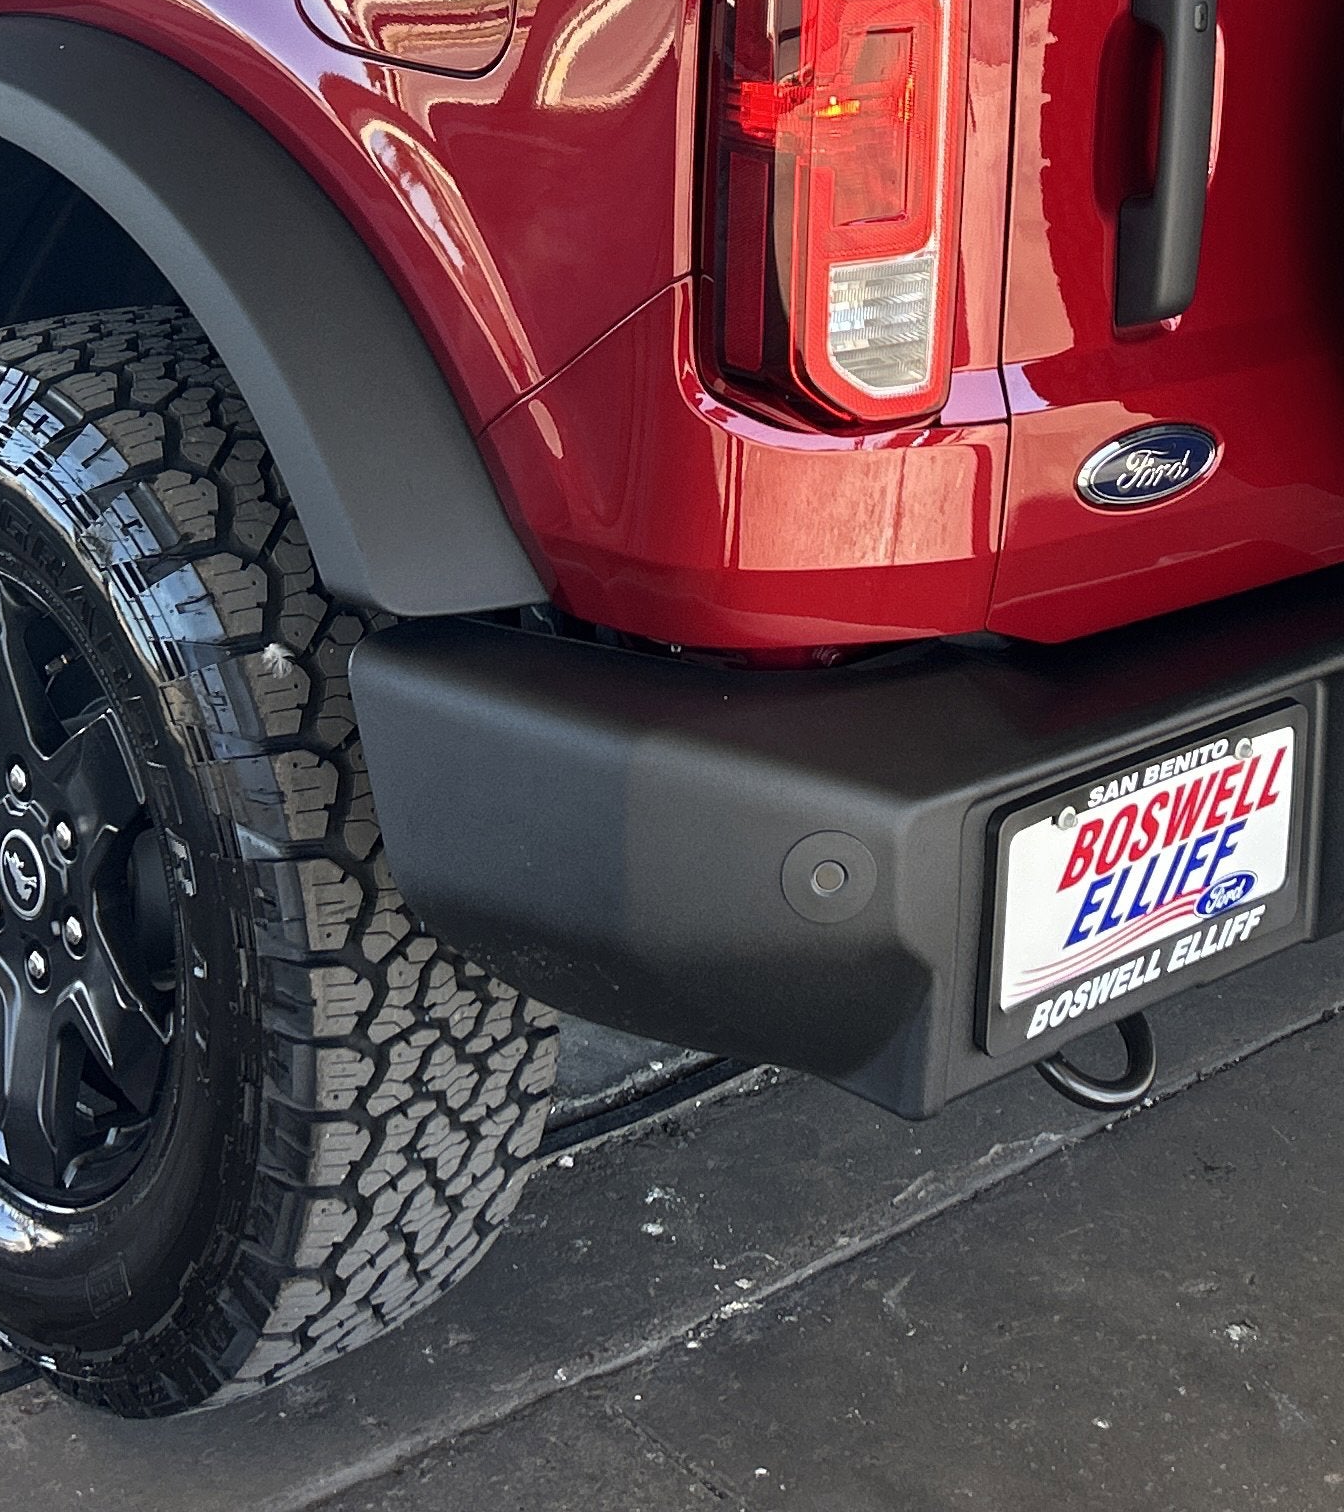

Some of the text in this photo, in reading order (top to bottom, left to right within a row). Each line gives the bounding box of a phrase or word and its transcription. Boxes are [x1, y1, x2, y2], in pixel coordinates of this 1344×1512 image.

[1056, 745, 1288, 894] BOSWELL
[1086, 738, 1230, 809] SAN BENITO
[1061, 818, 1249, 952] ELLIFF
[1025, 903, 1266, 1040] BOSWELL ELLIFF
